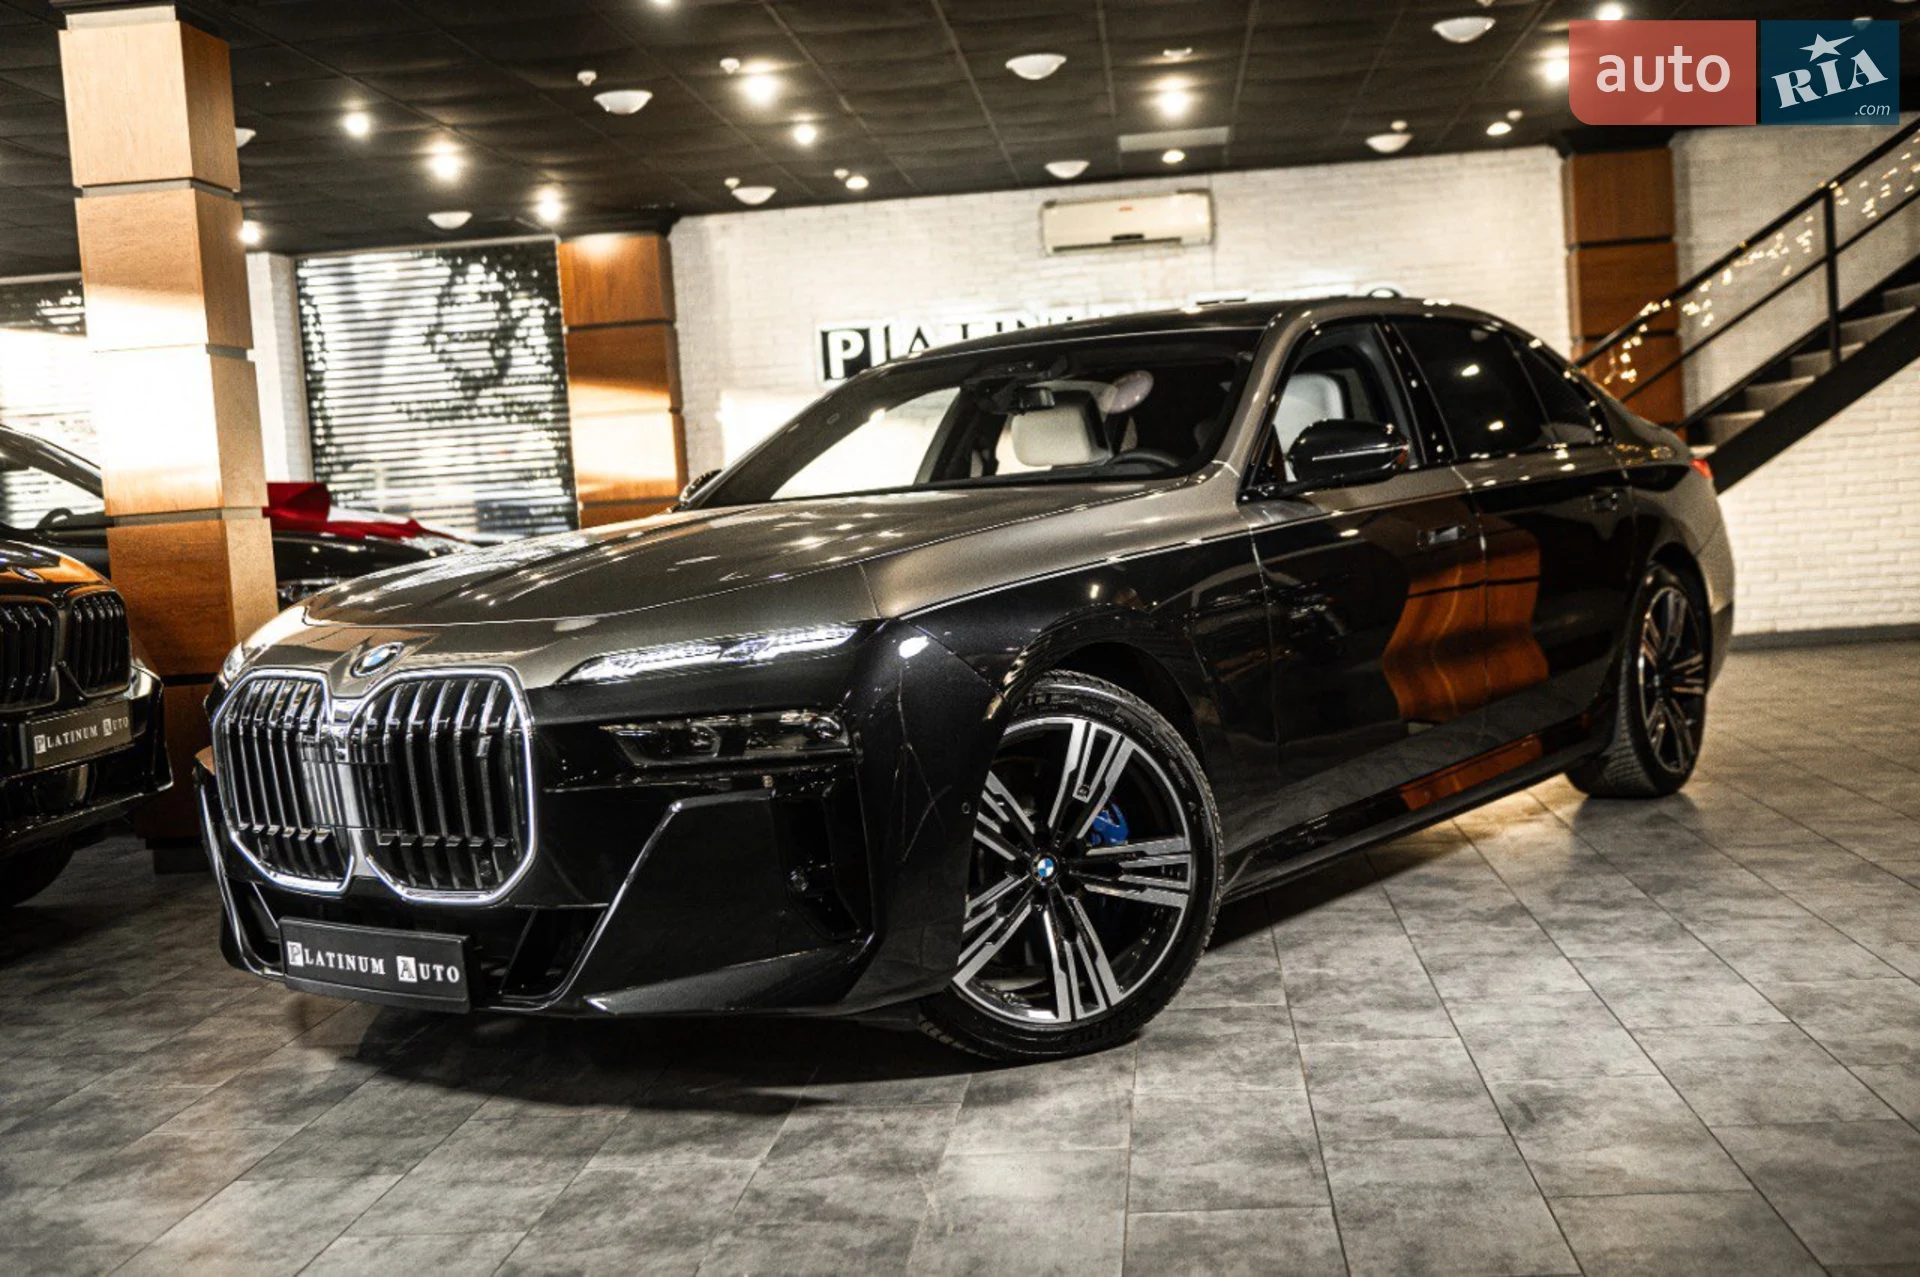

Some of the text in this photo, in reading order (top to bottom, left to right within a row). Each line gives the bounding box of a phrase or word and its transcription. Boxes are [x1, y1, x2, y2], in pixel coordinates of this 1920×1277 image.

[34, 717, 129, 754] PLATINUM AUTO
[287, 941, 460, 983] PLATINUM AUTO
